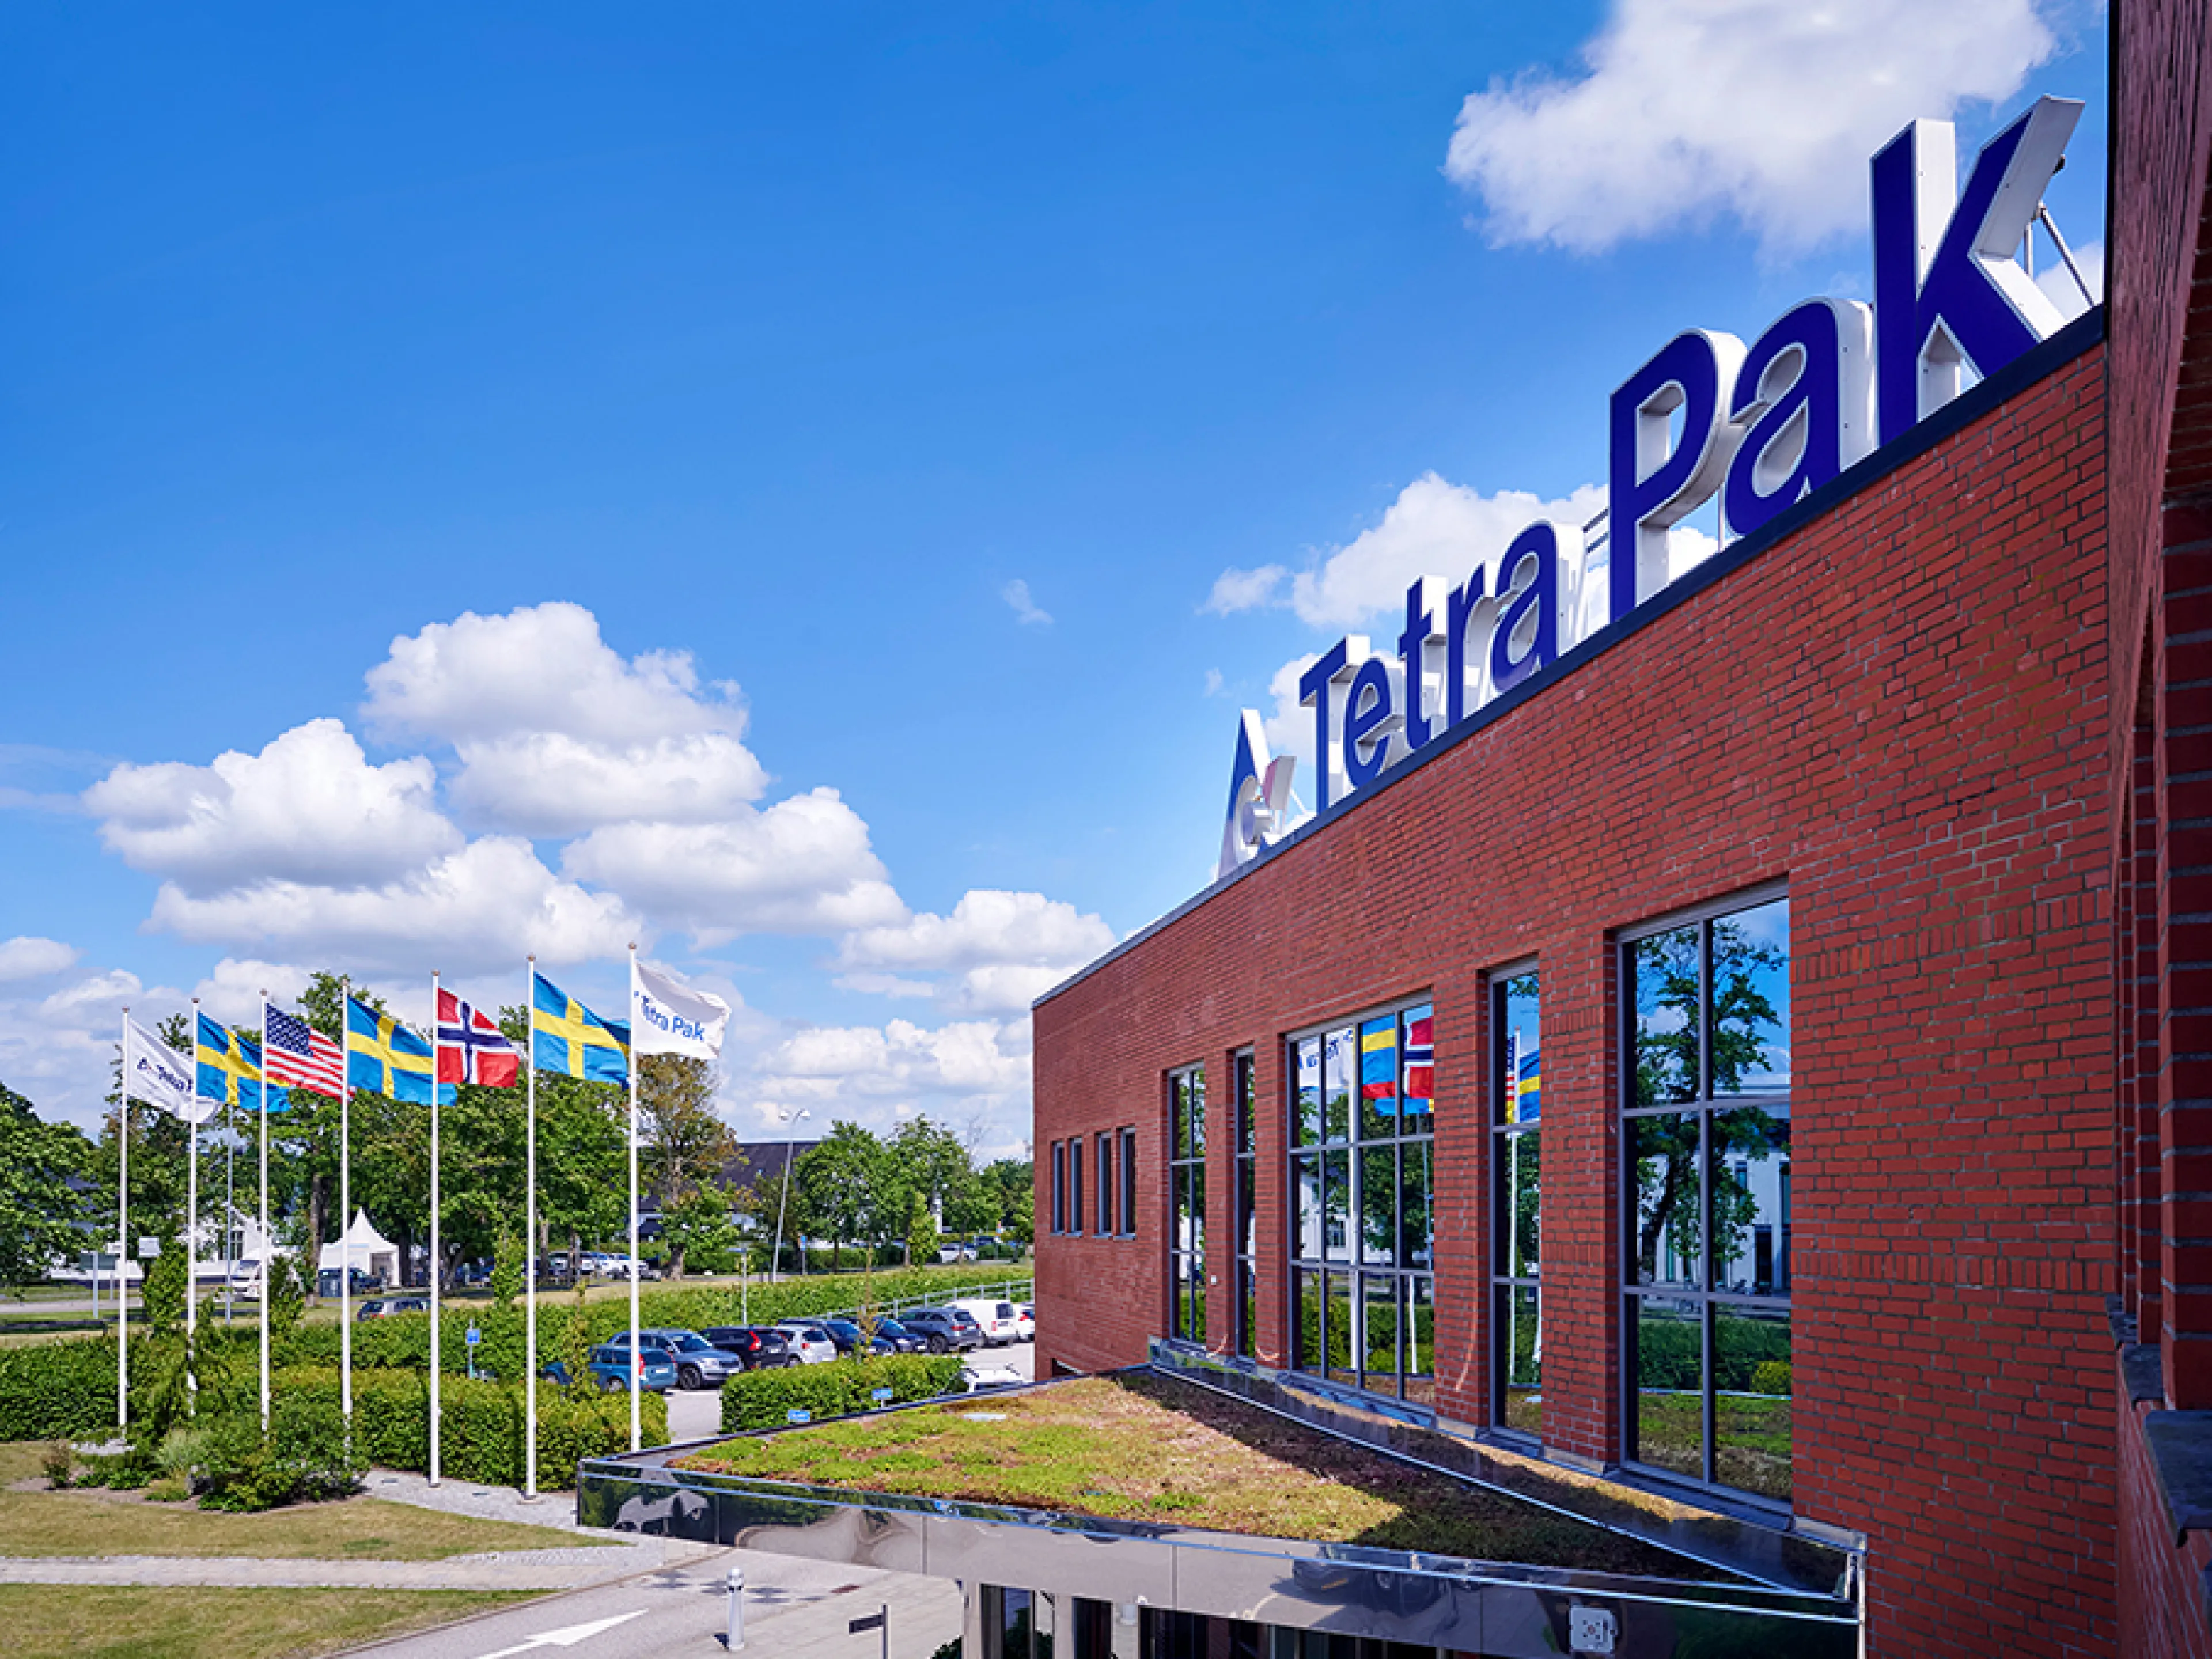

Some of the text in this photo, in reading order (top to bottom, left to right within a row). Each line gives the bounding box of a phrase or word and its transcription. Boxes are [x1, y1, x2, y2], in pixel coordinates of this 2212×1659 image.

[1299, 95, 2058, 817] Tetra Pak
[672, 1014, 705, 1043] Pak
